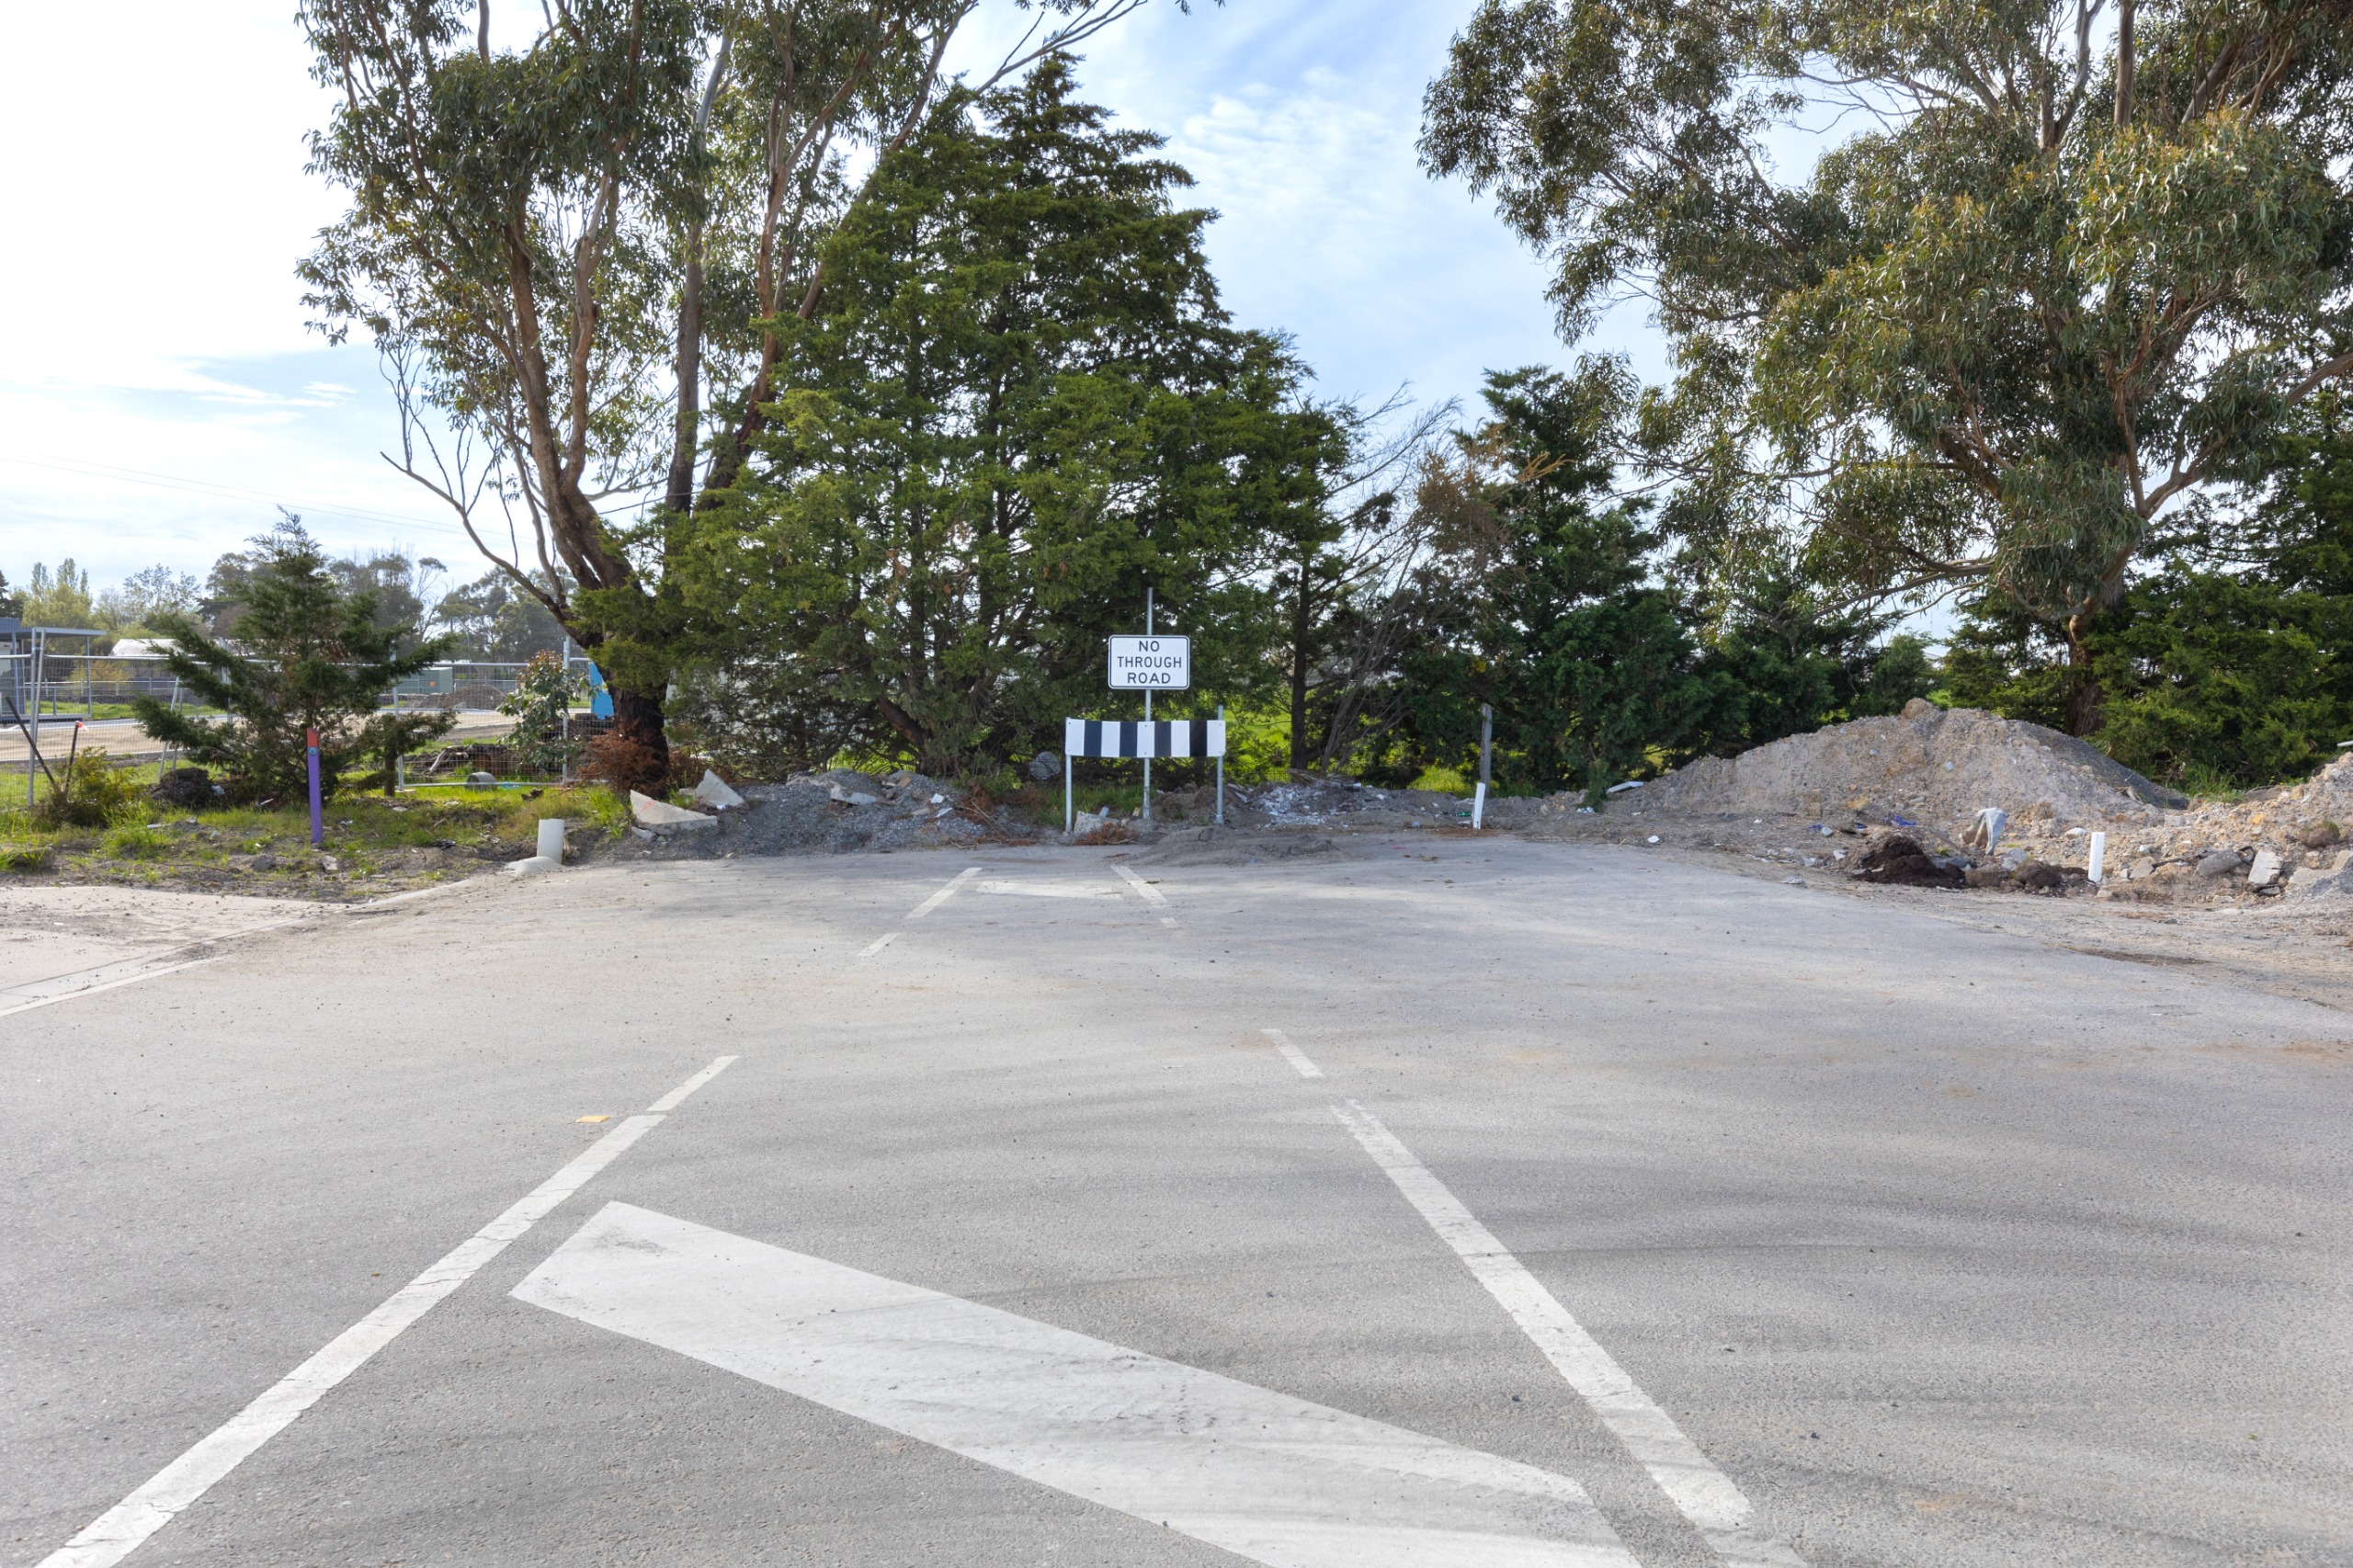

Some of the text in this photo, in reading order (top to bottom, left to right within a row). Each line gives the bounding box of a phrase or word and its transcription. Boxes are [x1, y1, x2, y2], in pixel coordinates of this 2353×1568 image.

[1139, 641, 1160, 652] NO
[1117, 656, 1182, 668] THROUGH
[1127, 672, 1171, 684] ROAD
